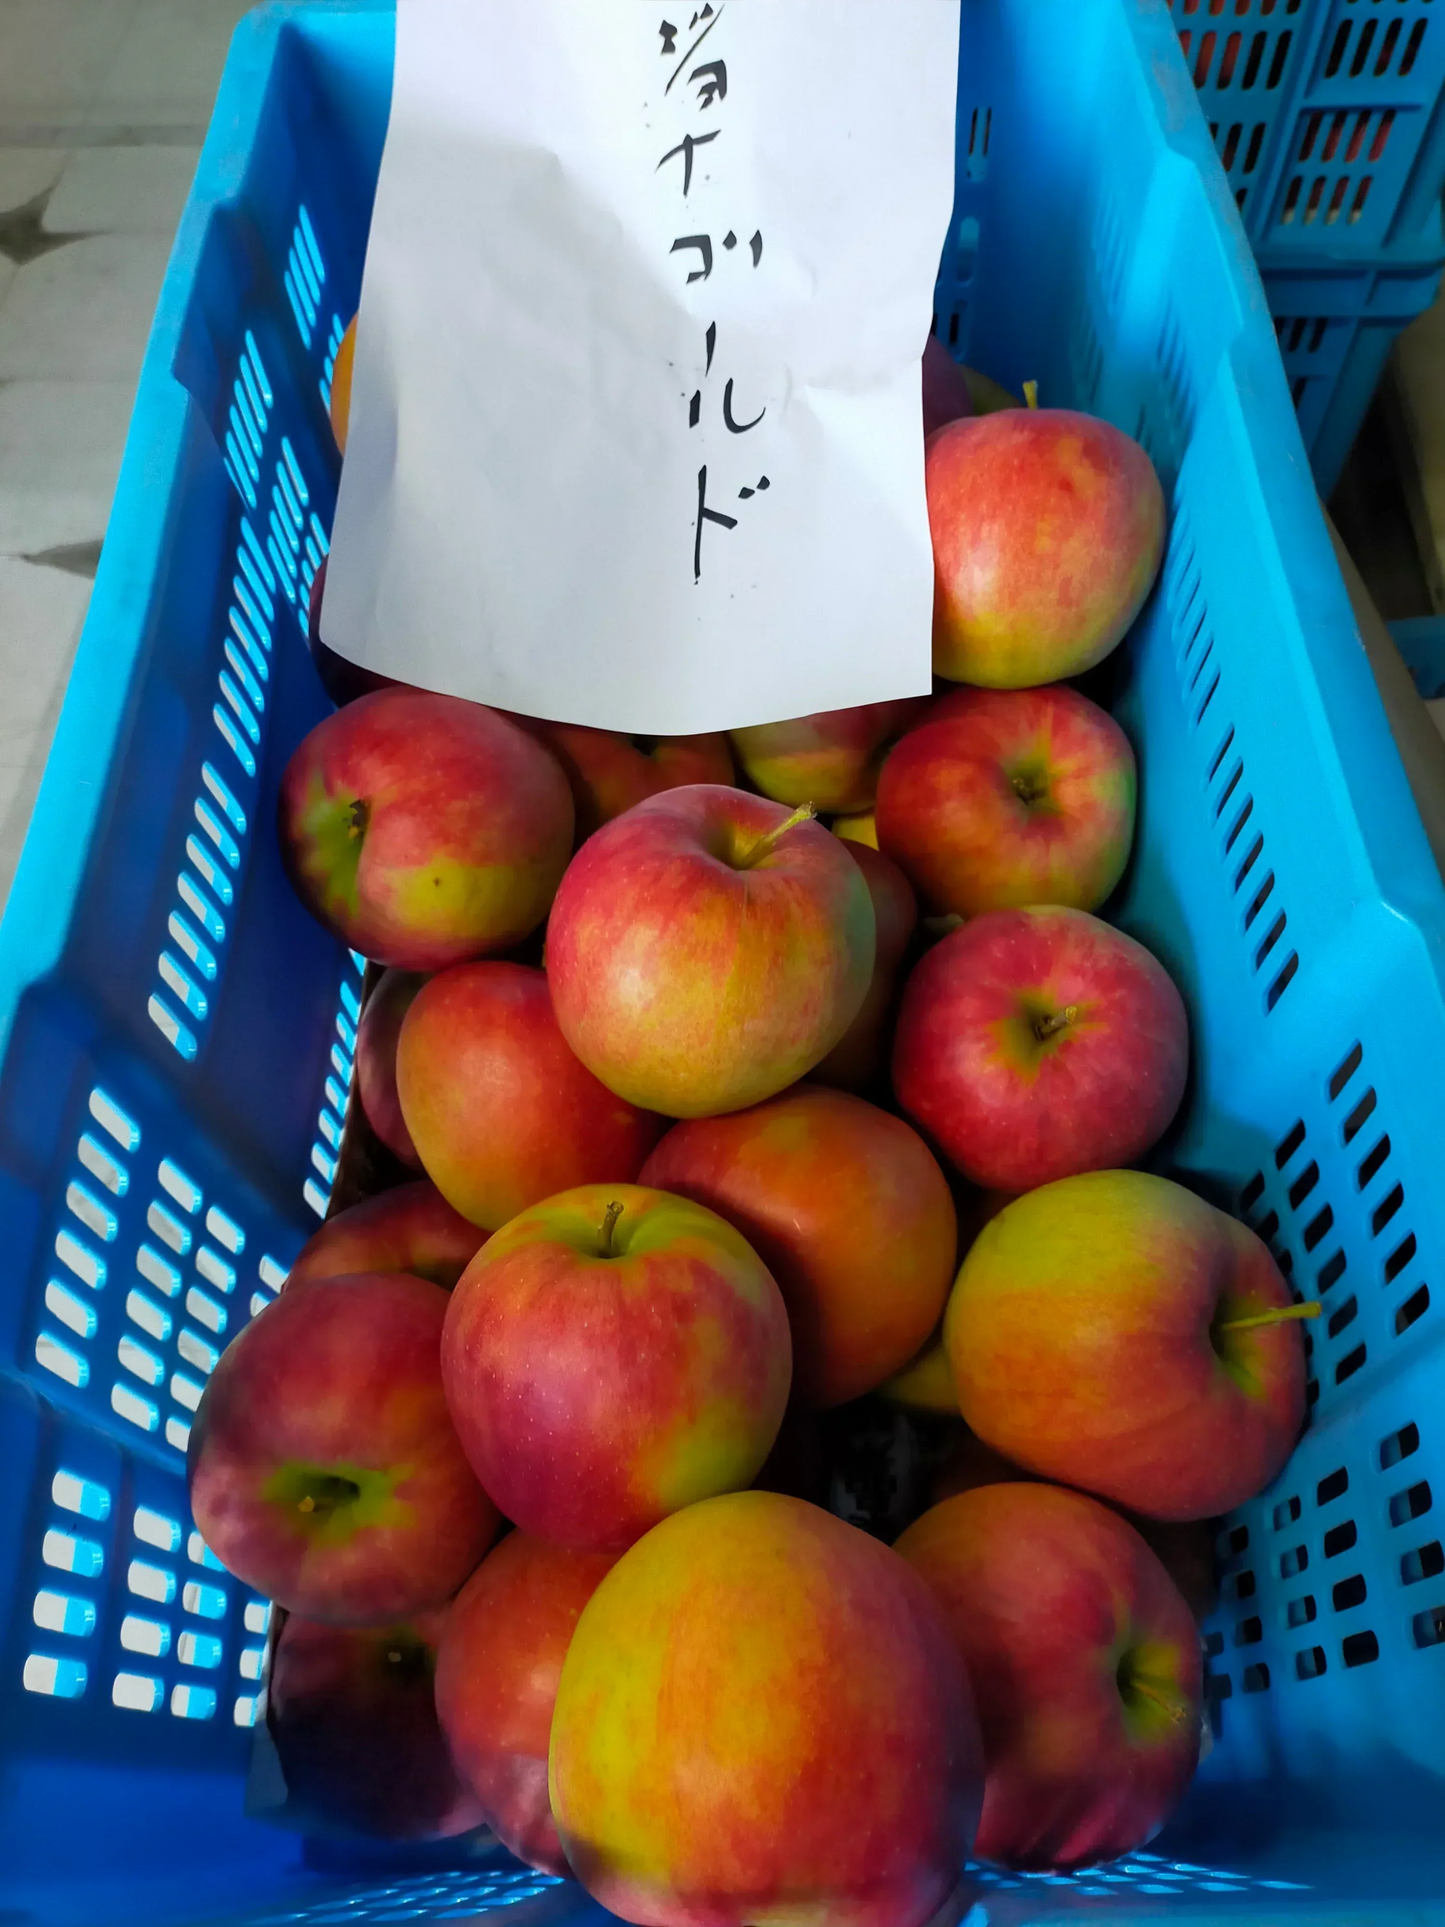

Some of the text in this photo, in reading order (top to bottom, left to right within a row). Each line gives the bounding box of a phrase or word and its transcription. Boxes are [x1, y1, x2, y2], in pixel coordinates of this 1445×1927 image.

[655, 3, 771, 582] ジョナゴールド
